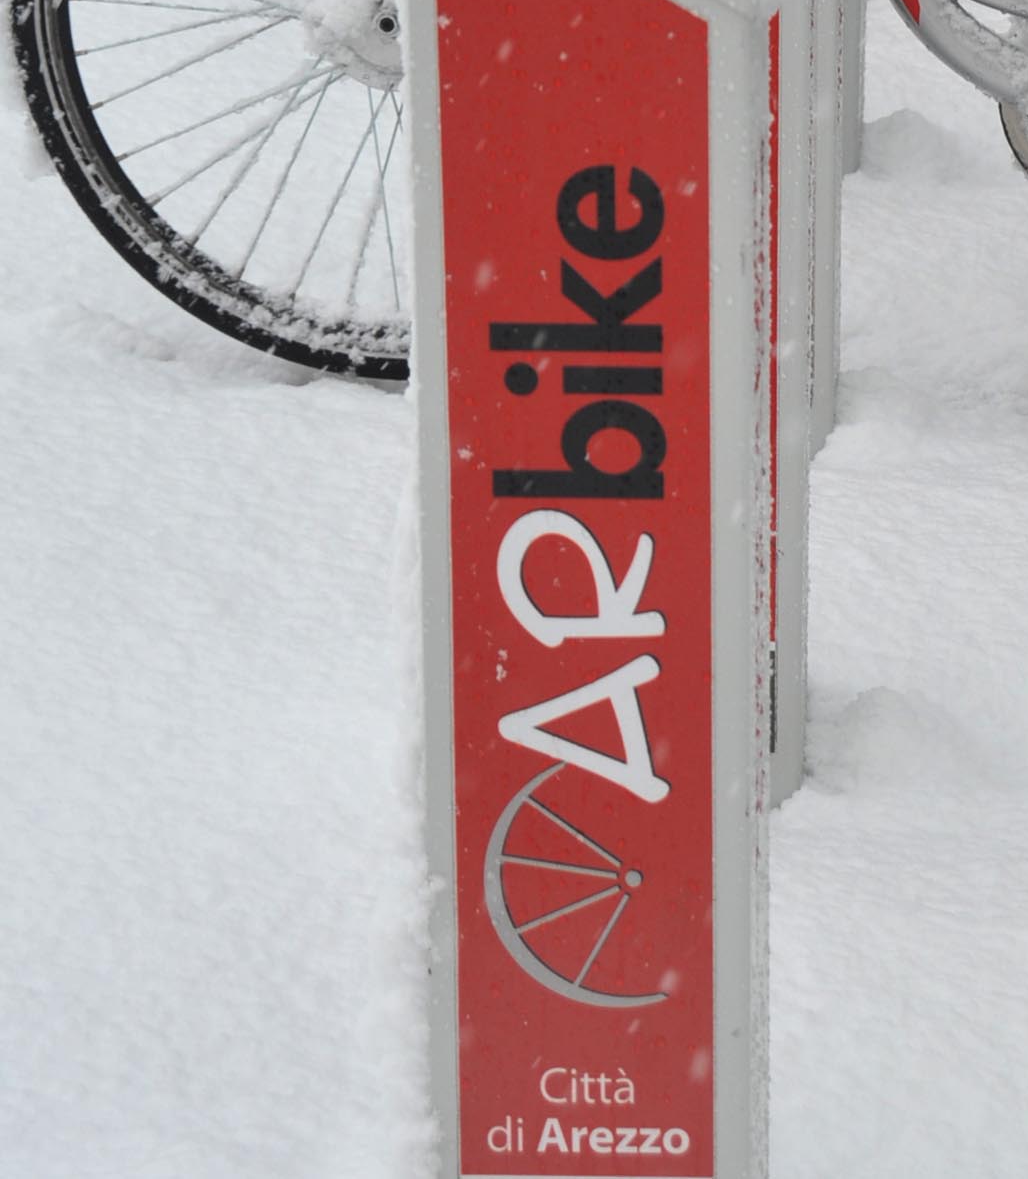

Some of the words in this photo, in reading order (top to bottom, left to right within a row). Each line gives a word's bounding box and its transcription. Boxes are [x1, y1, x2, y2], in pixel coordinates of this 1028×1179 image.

[539, 1067, 636, 1104] Città
[486, 1115, 524, 1153] di
[536, 1118, 690, 1154] Arezzo
